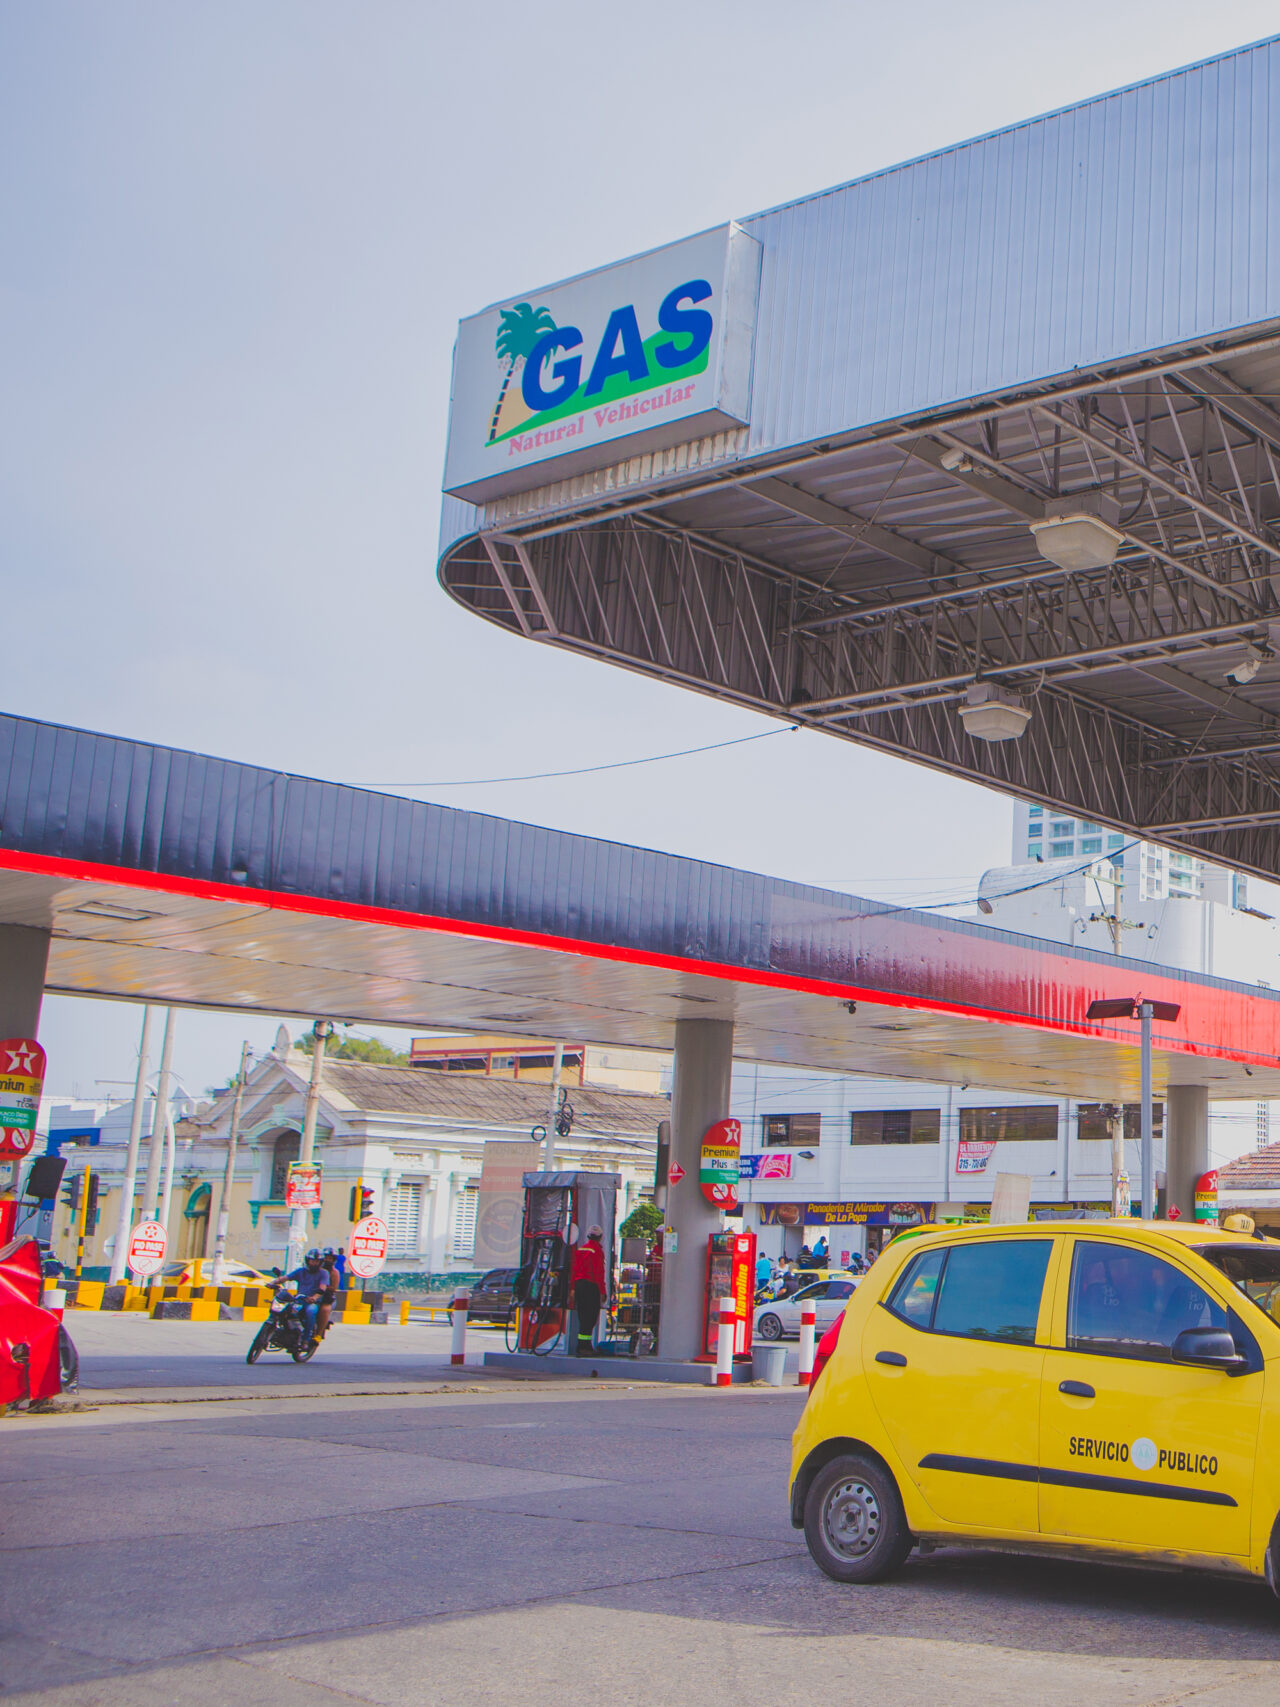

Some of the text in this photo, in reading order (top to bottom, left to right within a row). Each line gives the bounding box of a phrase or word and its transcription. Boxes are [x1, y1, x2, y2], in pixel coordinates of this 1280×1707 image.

[522, 279, 713, 412] GAS
[508, 383, 696, 456] Natural Vehicular
[711, 1159, 728, 1169] Plus
[825, 1213, 836, 1222] De
[845, 1203, 854, 1212] El
[854, 1203, 886, 1213] Mirador
[735, 1263, 748, 1317] Havoline
[1069, 1436, 1129, 1463] SERVICIO
[1159, 1449, 1218, 1476] PUBLICO
